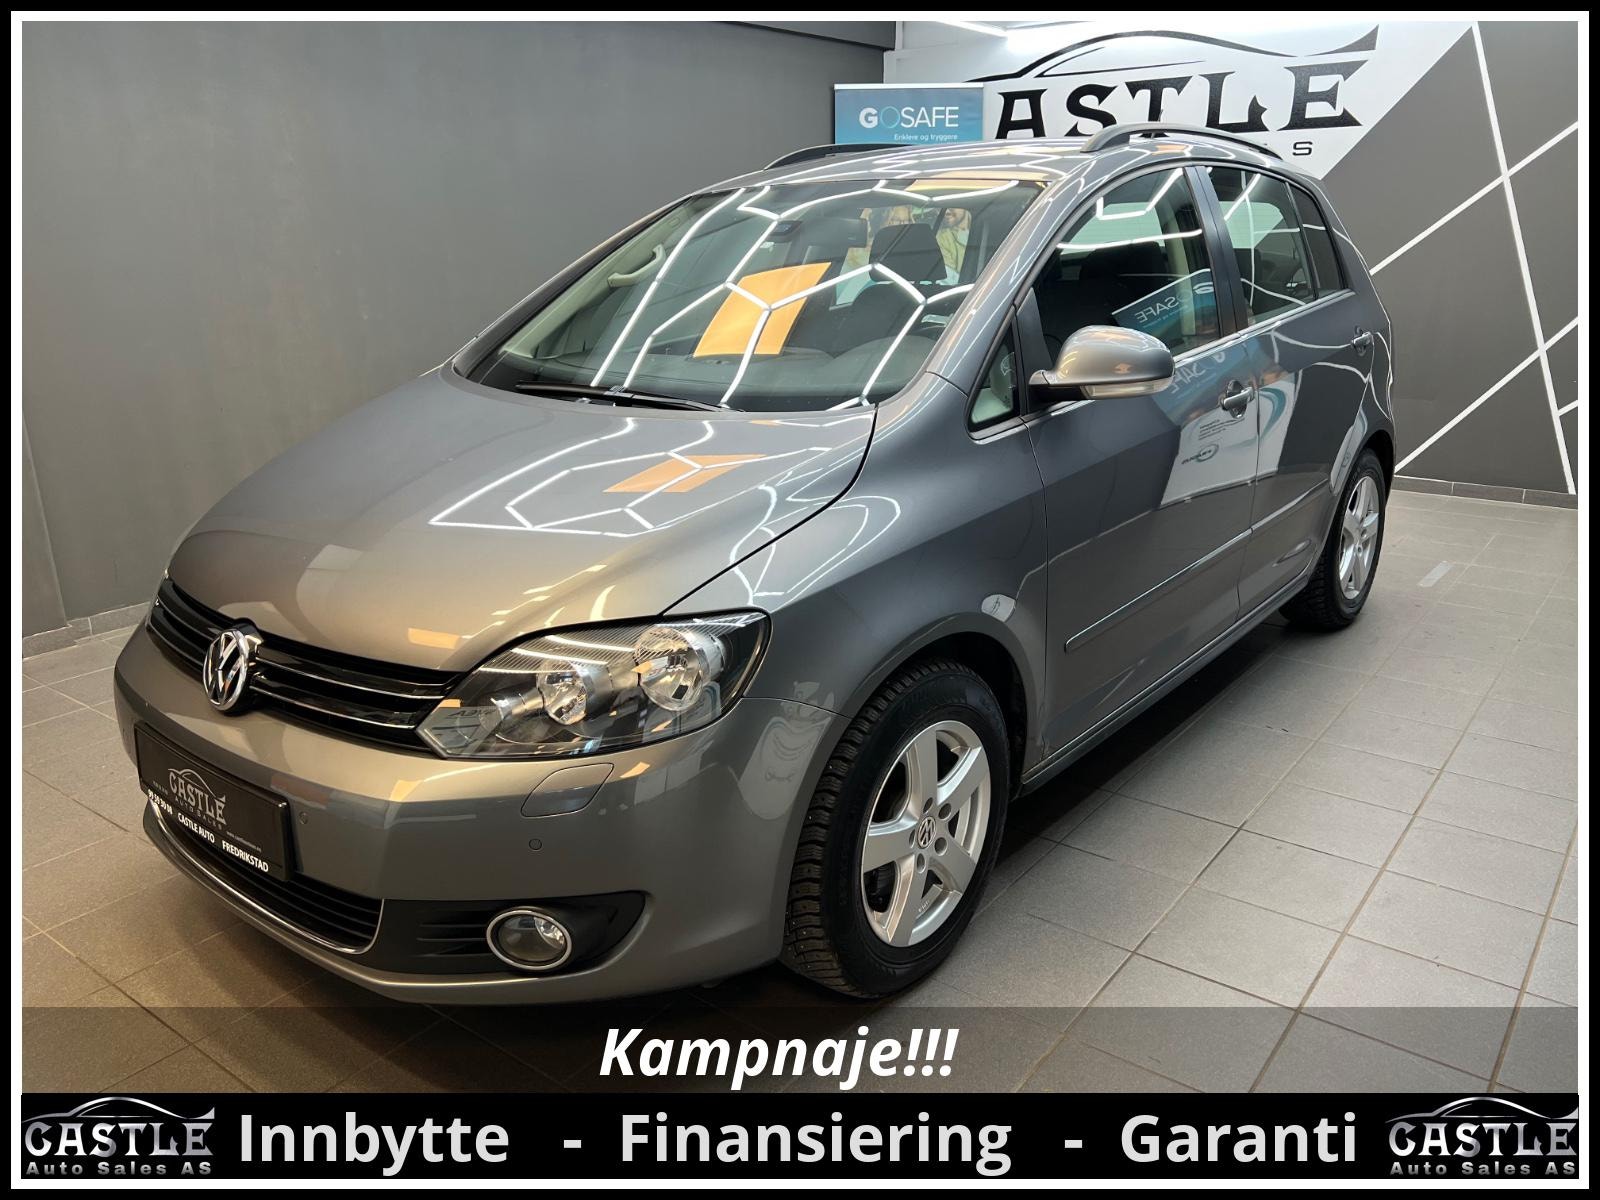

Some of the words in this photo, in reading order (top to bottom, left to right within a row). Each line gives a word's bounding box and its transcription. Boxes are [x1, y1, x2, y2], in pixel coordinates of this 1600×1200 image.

[859, 106, 960, 129] GOSAFE
[169, 771, 227, 825] CASTLE
[177, 812, 199, 833] CASTLE
[198, 825, 216, 844] AUTO
[221, 839, 269, 873] FREDRIKSTAD
